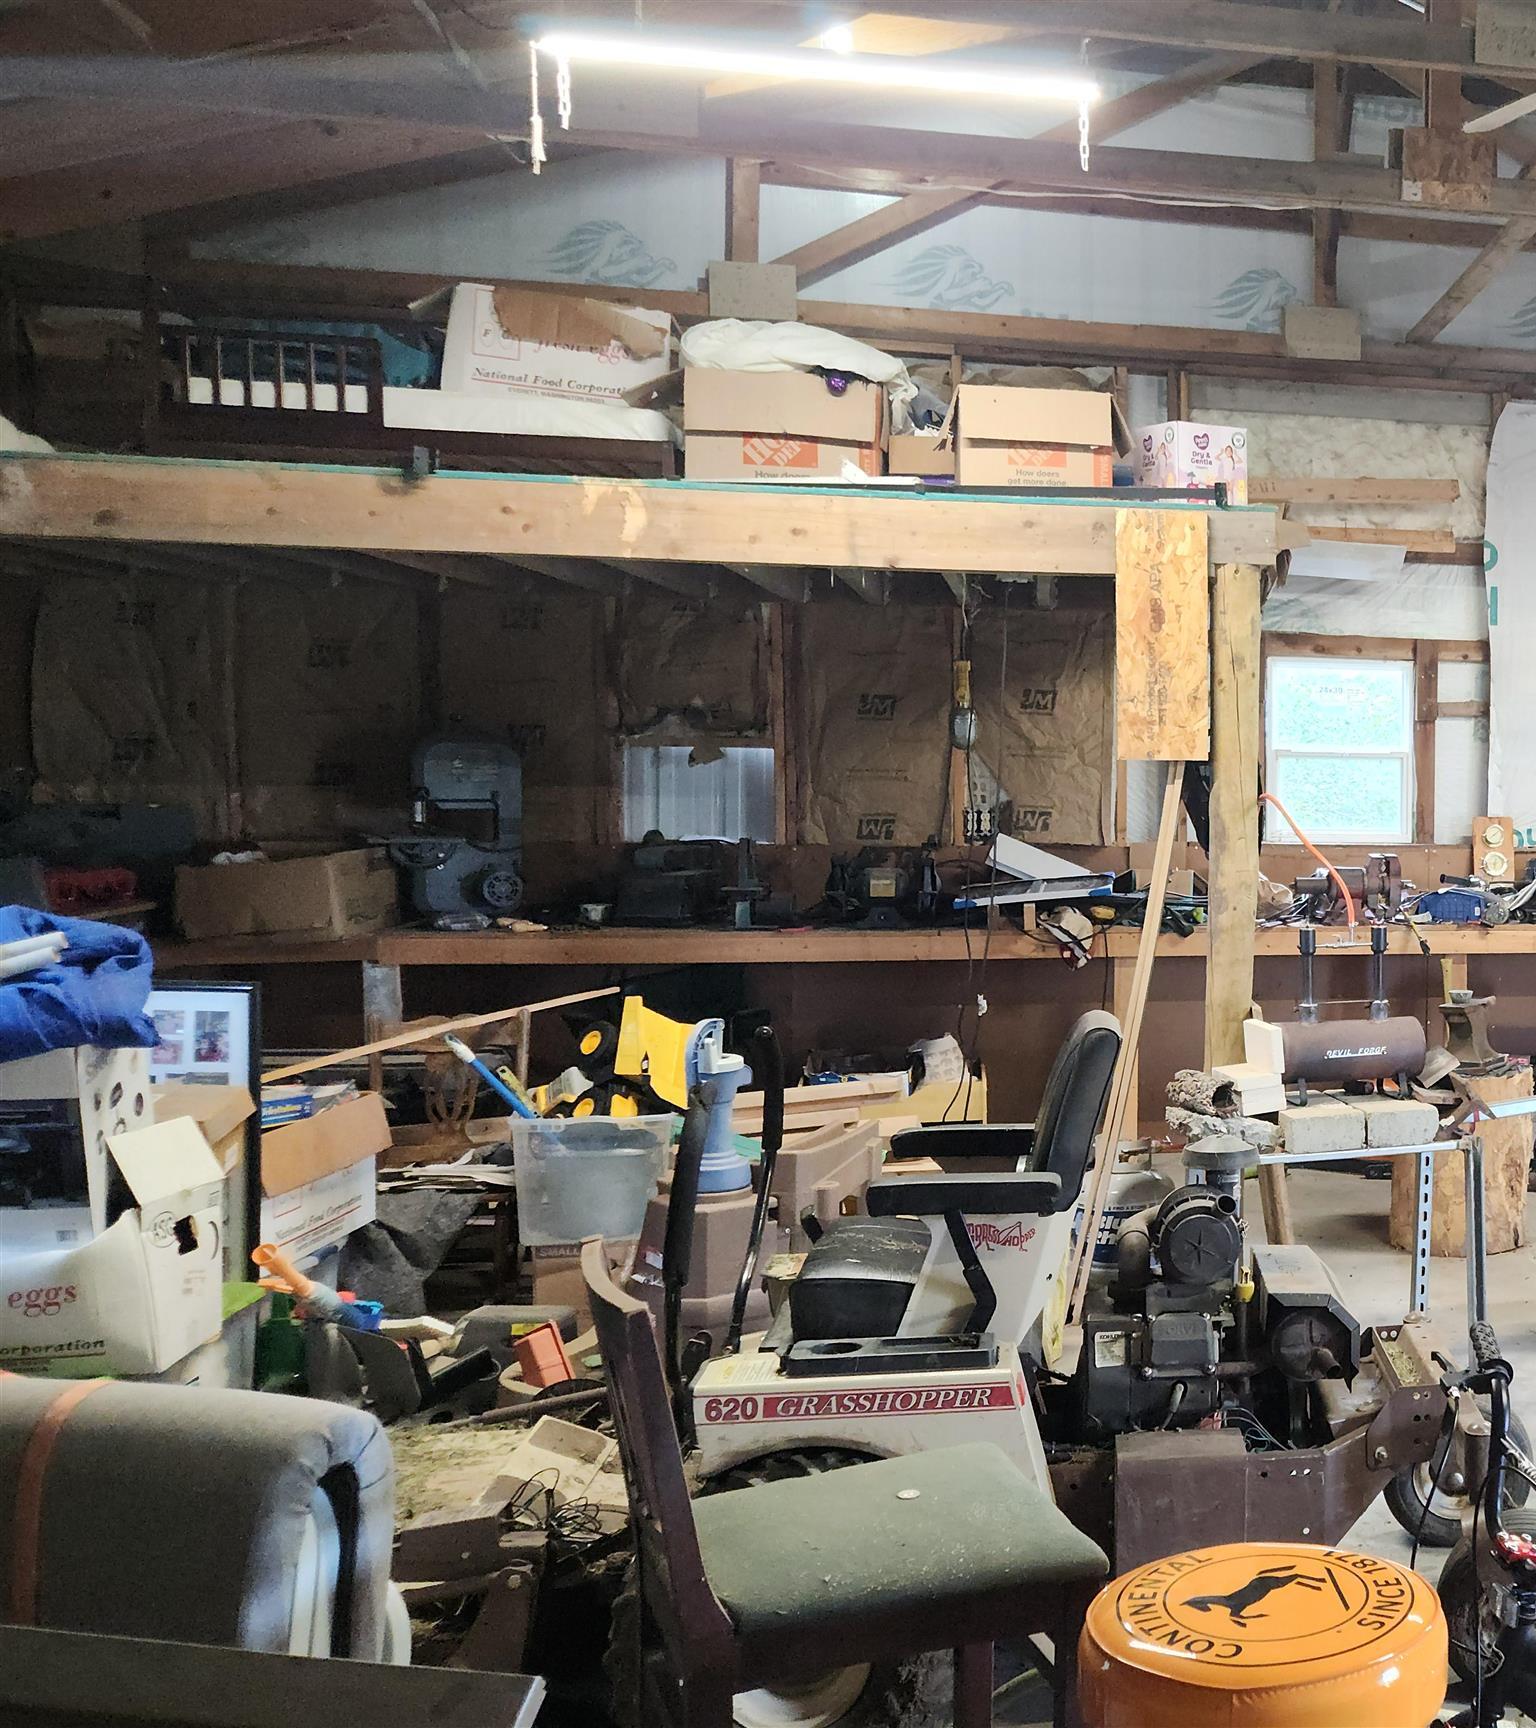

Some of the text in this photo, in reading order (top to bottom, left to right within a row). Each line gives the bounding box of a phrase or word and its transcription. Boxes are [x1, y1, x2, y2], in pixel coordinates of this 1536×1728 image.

[473, 367, 623, 394] National Food Corporat
[1192, 451, 1205, 460] Dry
[1037, 470, 1060, 478] doers
[1327, 1046, 1386, 1058] DEVIL FORGE
[540, 1247, 580, 1257] SMALL
[8, 1284, 78, 1318] eggs
[0, 1339, 105, 1355] orporation
[704, 1387, 993, 1422] 620 GRASSHOPPER
[1322, 1550, 1405, 1631] SINCE 1871
[1127, 1553, 1244, 1659] CONTINENTAL
